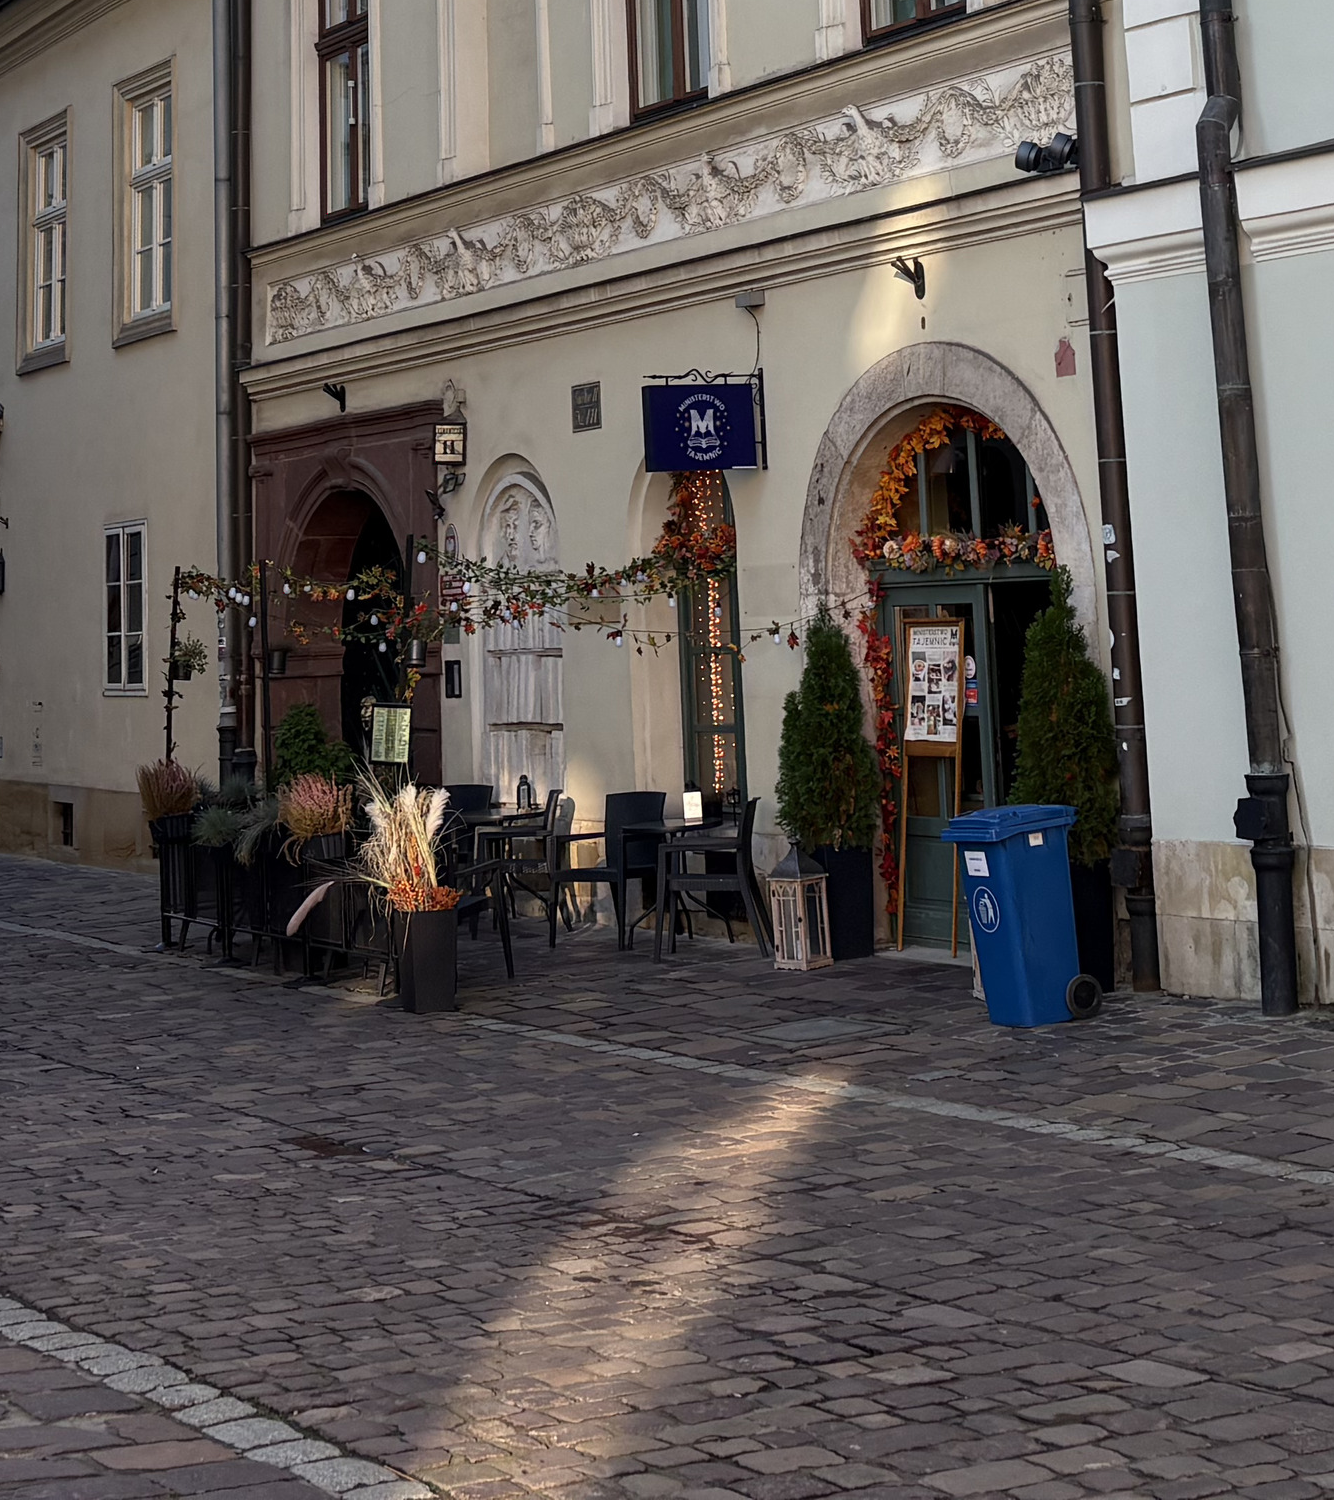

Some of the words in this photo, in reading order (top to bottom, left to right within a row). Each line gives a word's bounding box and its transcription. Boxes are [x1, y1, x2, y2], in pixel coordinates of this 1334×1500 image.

[678, 393, 726, 412] MINISTERSTWO
[686, 447, 723, 461] TAJEMNIC
[913, 637, 947, 645] TAJEMNIC
